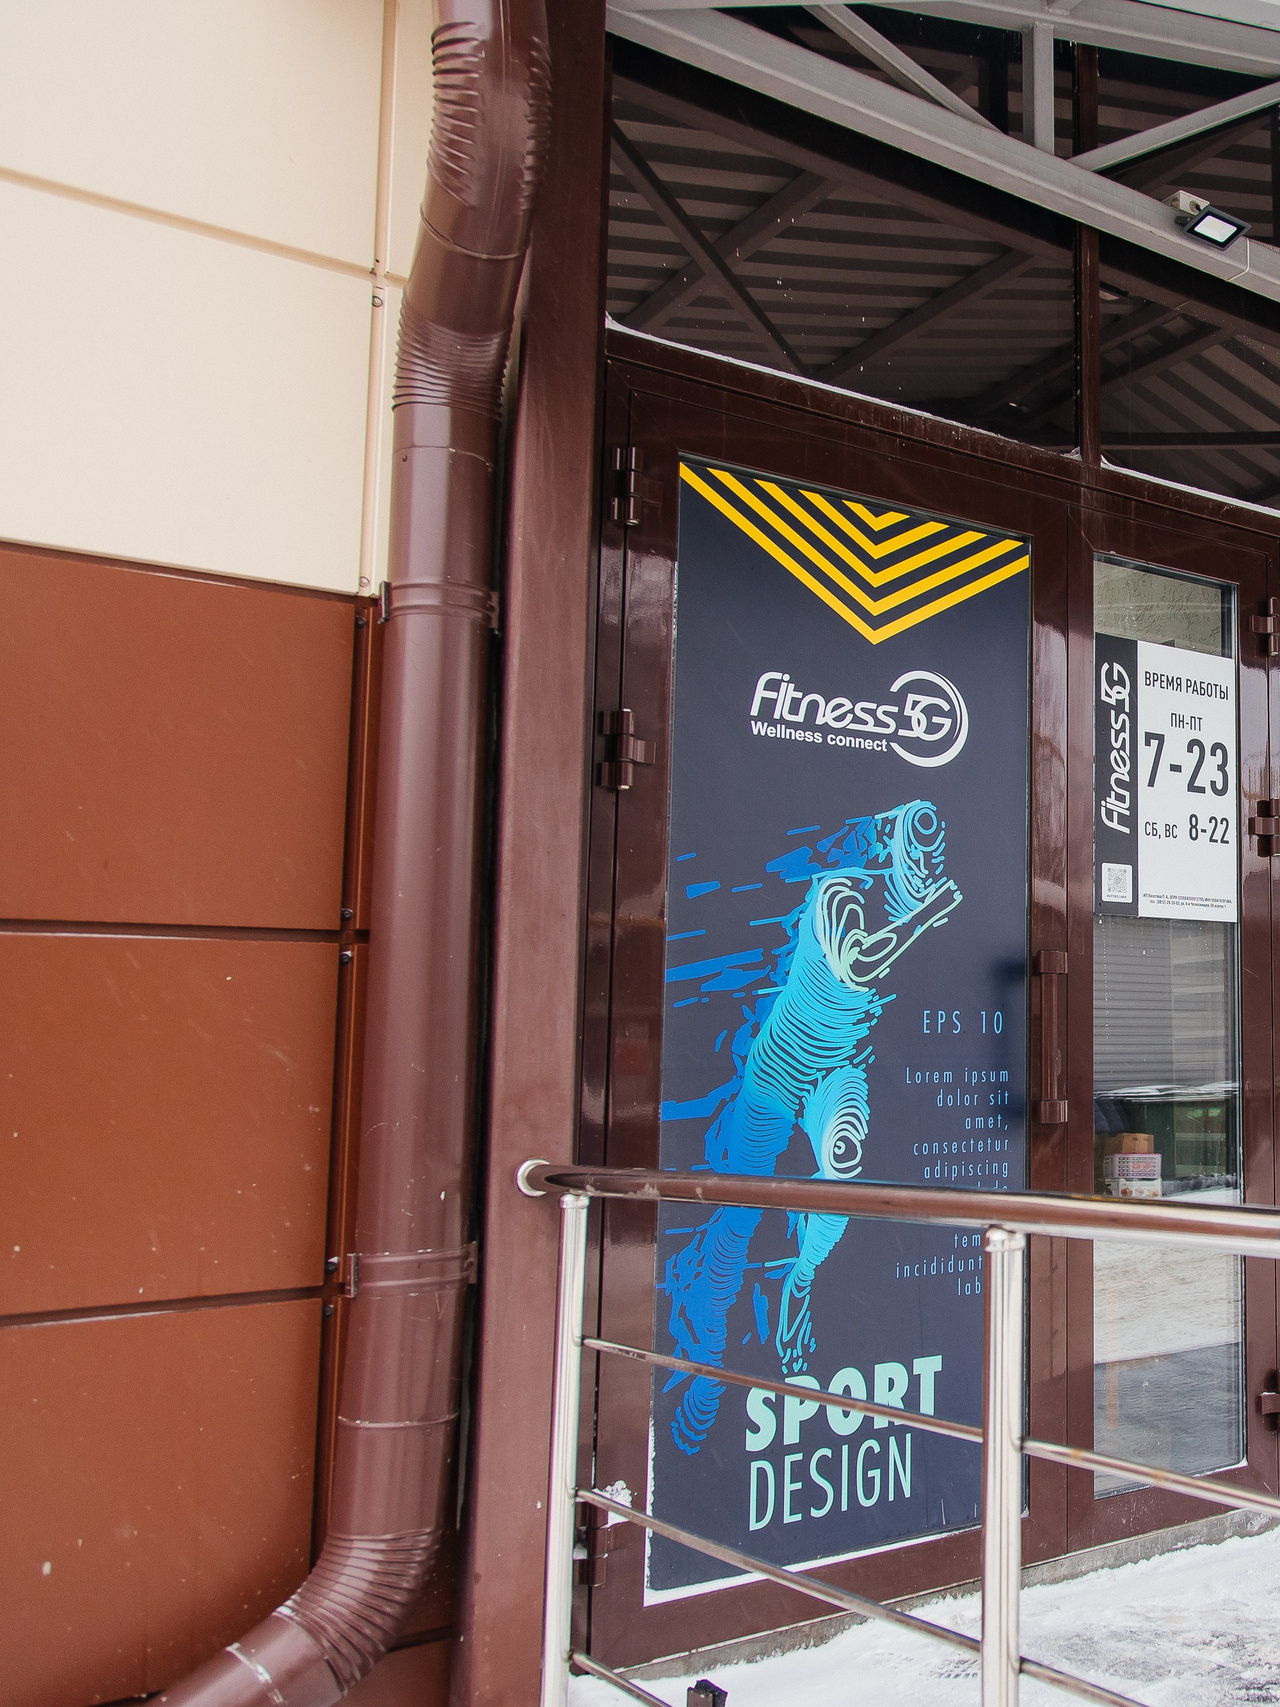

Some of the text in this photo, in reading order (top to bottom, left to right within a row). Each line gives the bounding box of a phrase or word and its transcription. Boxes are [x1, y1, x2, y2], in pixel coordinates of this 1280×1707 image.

[1144, 670, 1229, 701] ВРЕМЯ РАБОТЫ
[1170, 712, 1203, 731] ПН-ПТ
[750, 720, 888, 752] Wellness connect
[1144, 731, 1229, 797] 7-23
[1144, 813, 1230, 845] СБ, ВС 8-22
[923, 1010, 1003, 1034] EPS 10
[906, 1067, 1009, 1087] Lorem ipsum
[937, 1088, 1009, 1107] dolor sit
[965, 1113, 1009, 1131] amet,
[913, 1137, 1009, 1156] consectetur
[924, 1160, 1009, 1181] adipiscing
[954, 1232, 981, 1249] tem
[896, 1254, 983, 1279] incididunt
[957, 1278, 981, 1296] lab
[745, 1354, 943, 1452] SPORT
[749, 1432, 912, 1532] DESIGN
